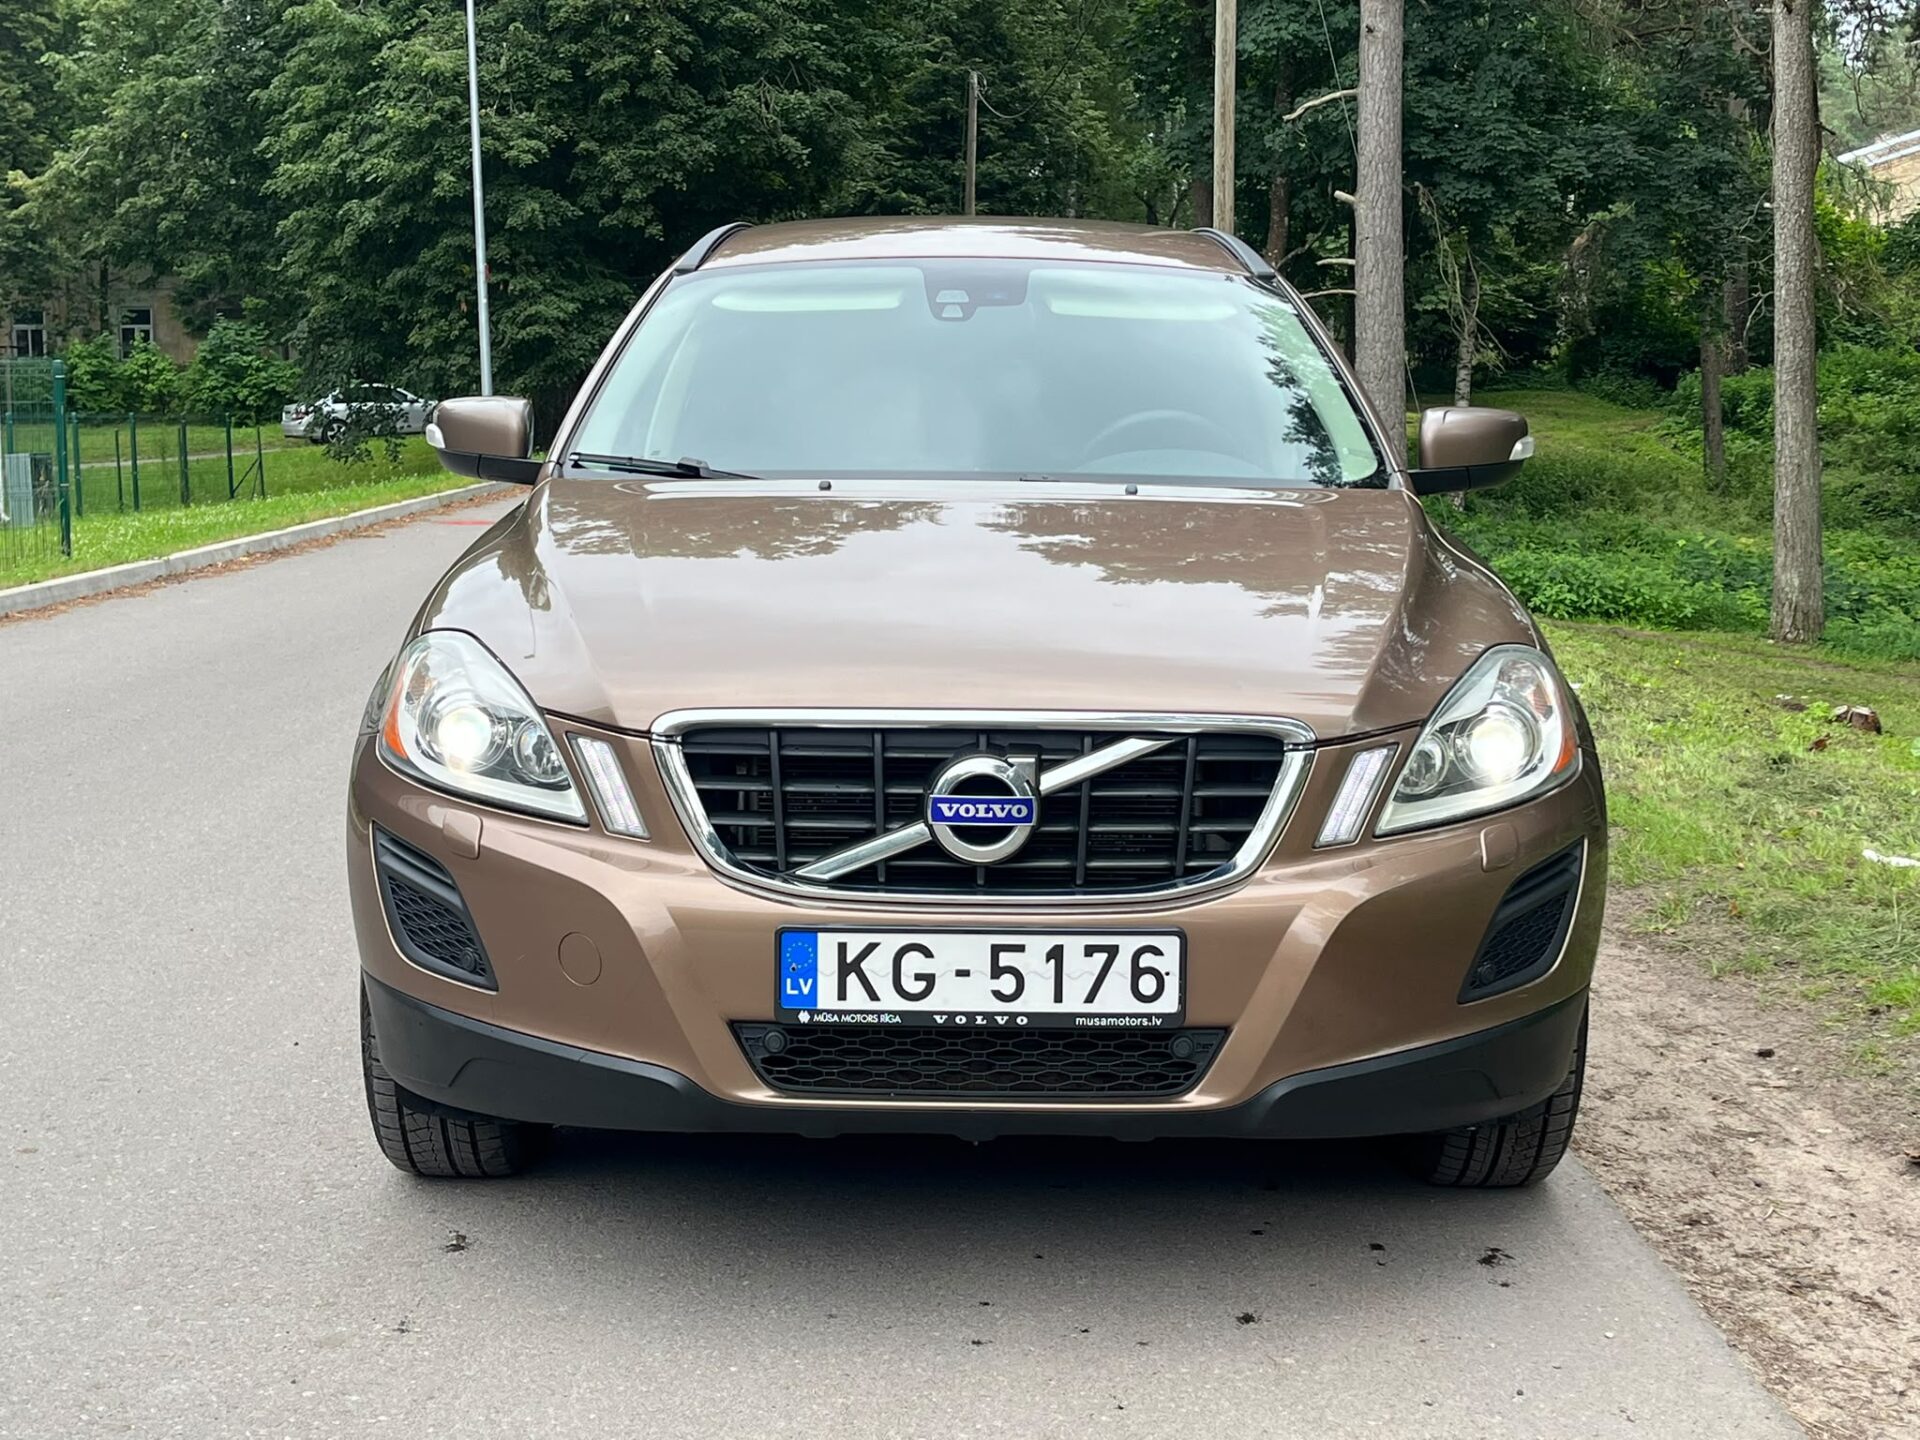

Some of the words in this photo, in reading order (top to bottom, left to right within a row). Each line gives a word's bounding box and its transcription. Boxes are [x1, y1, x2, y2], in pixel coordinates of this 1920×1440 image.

[937, 803, 1028, 818] VOLVO
[836, 941, 1166, 1004] KG-5176
[786, 978, 813, 995] LV
[841, 1014, 878, 1024] MOTORS
[933, 1015, 1028, 1026] VOLVO
[1075, 1016, 1162, 1026] musamotors.lv
